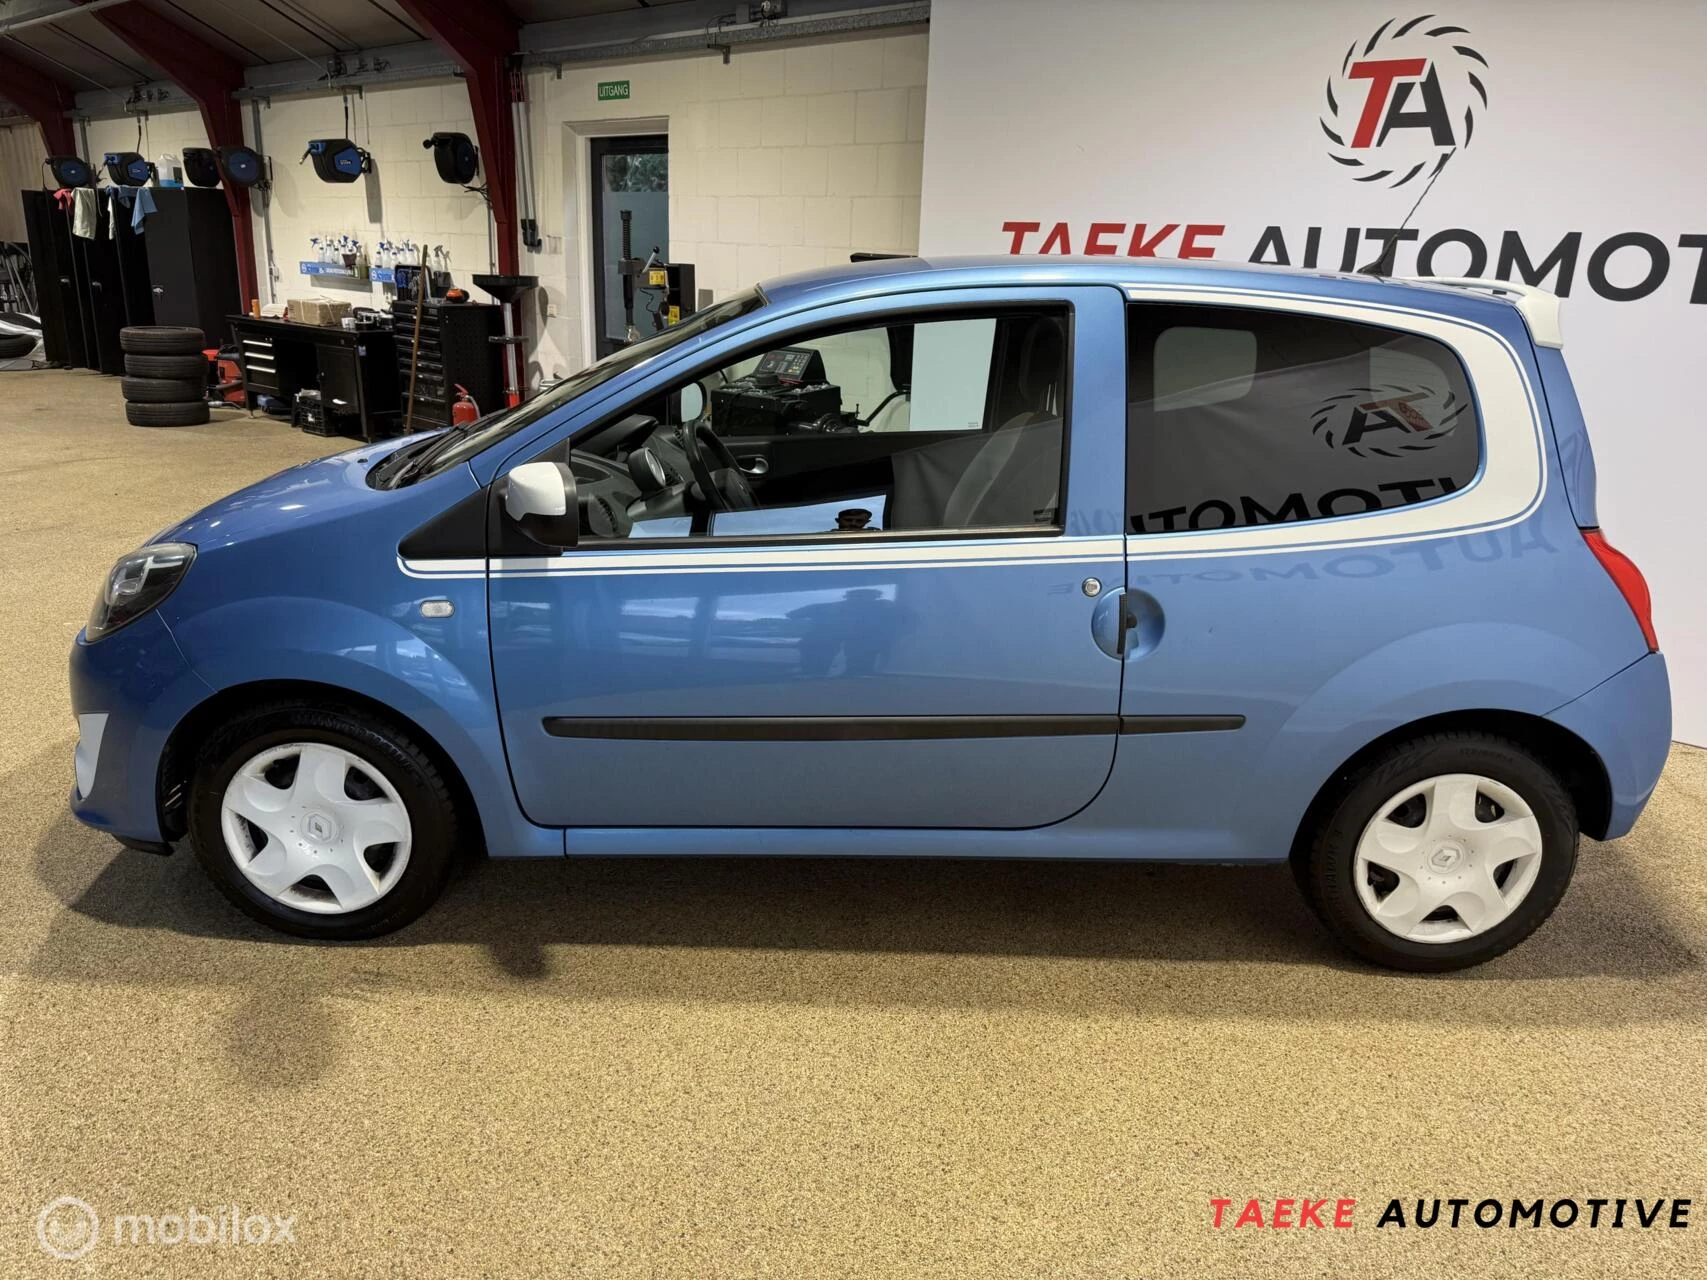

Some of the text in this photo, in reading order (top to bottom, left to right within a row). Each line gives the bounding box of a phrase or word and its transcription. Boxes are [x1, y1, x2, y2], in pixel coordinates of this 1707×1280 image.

[599, 84, 629, 97] UITGANG
[1348, 57, 1457, 149] TA
[1002, 222, 1226, 259] TAEKE
